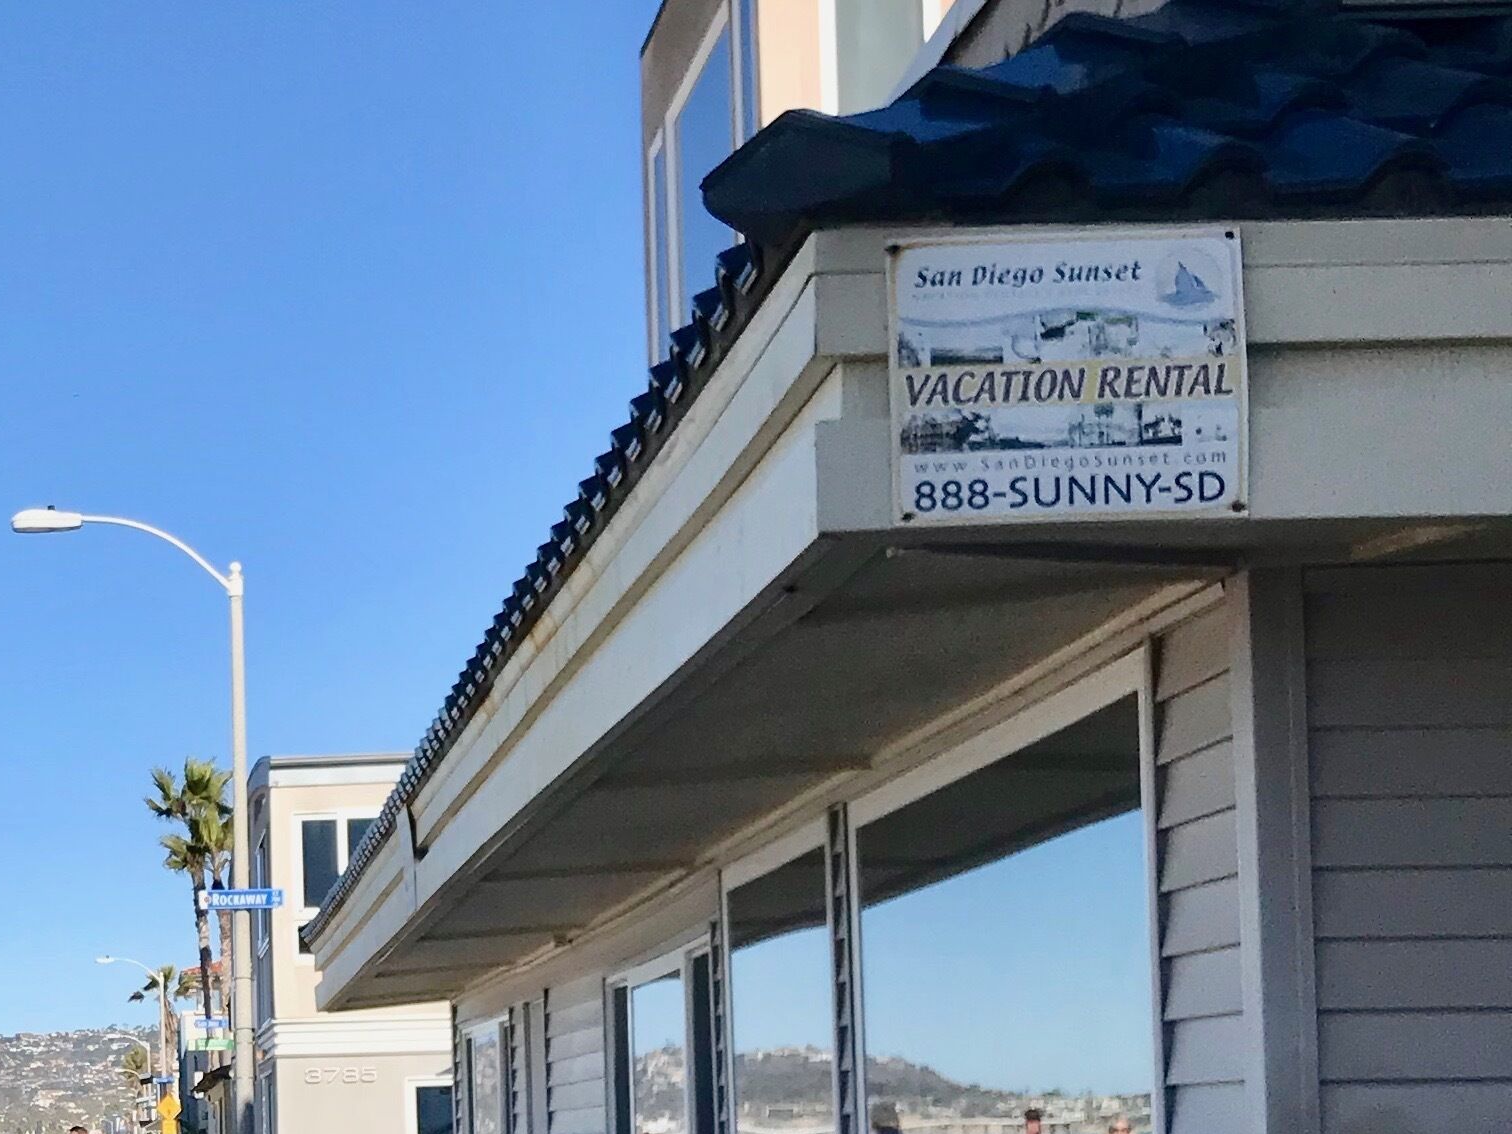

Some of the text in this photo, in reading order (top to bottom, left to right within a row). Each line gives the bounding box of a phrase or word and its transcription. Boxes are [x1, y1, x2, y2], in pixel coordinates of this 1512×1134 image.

[914, 260, 1143, 288] San Diego Sunset
[904, 363, 1234, 407] VACATION RENTAL
[913, 470, 1226, 513] 888-SUNNY-SD
[212, 893, 268, 906] ROCKAWAY
[304, 1066, 378, 1085] 3785
